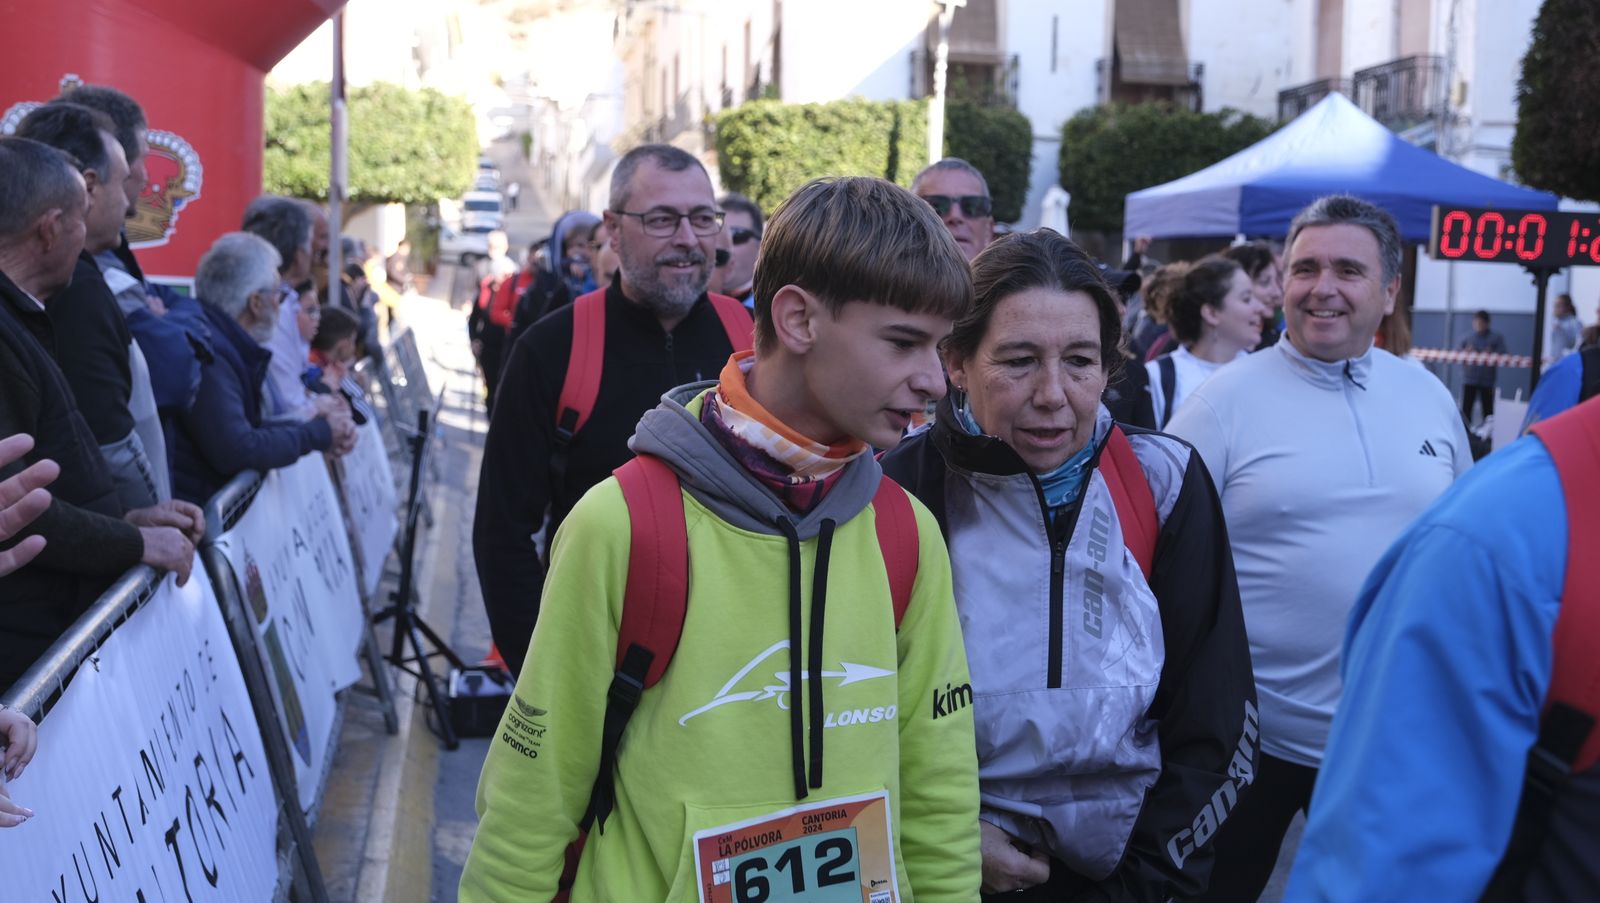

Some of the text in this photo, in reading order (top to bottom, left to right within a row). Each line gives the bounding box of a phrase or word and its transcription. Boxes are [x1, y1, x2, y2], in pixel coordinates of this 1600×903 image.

[1083, 506, 1110, 640] can-am
[932, 682, 974, 720] kim
[808, 704, 897, 729] LONSO
[502, 732, 538, 759] aramco
[1167, 699, 1259, 870] can-am
[802, 809, 848, 826] CANTORIA
[802, 824, 823, 834] 2024
[718, 829, 783, 858] LA PÓLVORA
[734, 837, 856, 903] 612
